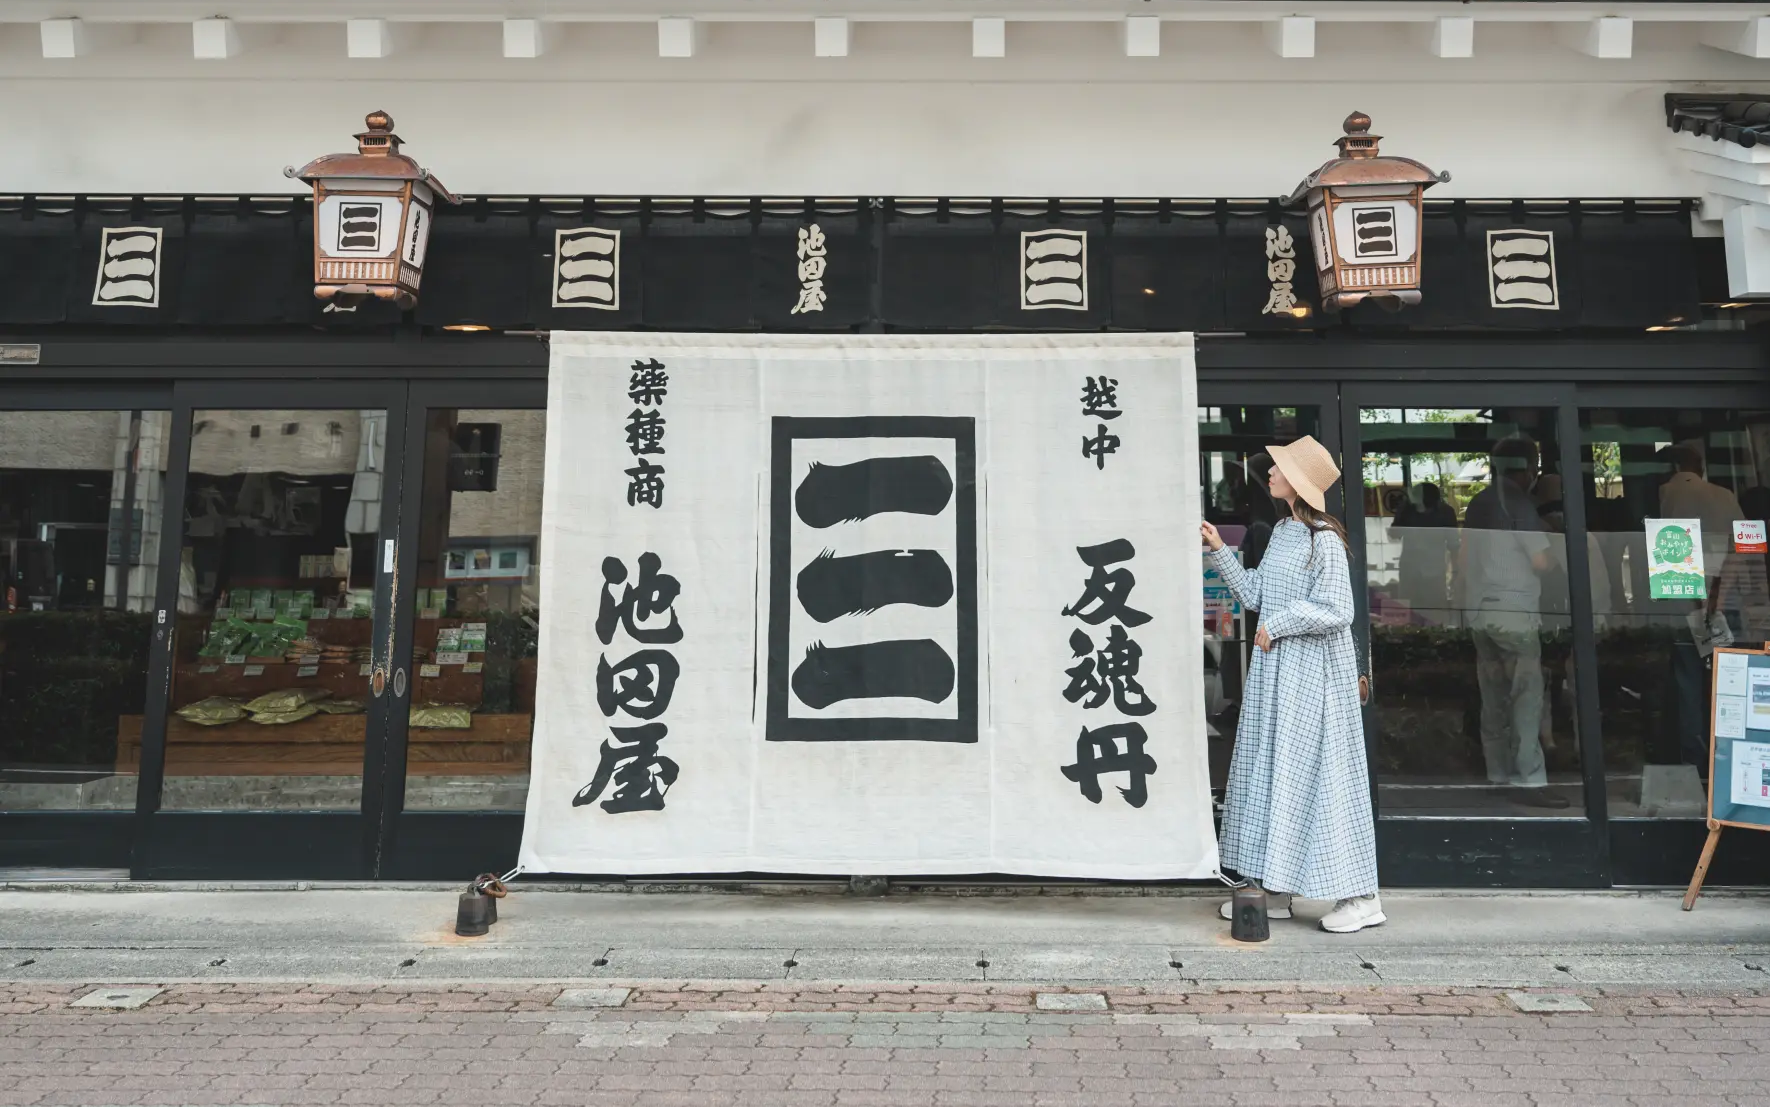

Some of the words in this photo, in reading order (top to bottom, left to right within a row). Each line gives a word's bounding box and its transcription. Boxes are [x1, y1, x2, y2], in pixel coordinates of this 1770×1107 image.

[790, 223, 828, 315] 池田屋
[1261, 224, 1297, 315] 池田屋
[1079, 375, 1123, 471] 越中
[1661, 584, 1695, 595] 加盟店
[571, 551, 684, 815] 池田屋
[1060, 538, 1158, 809] 反魂丹
